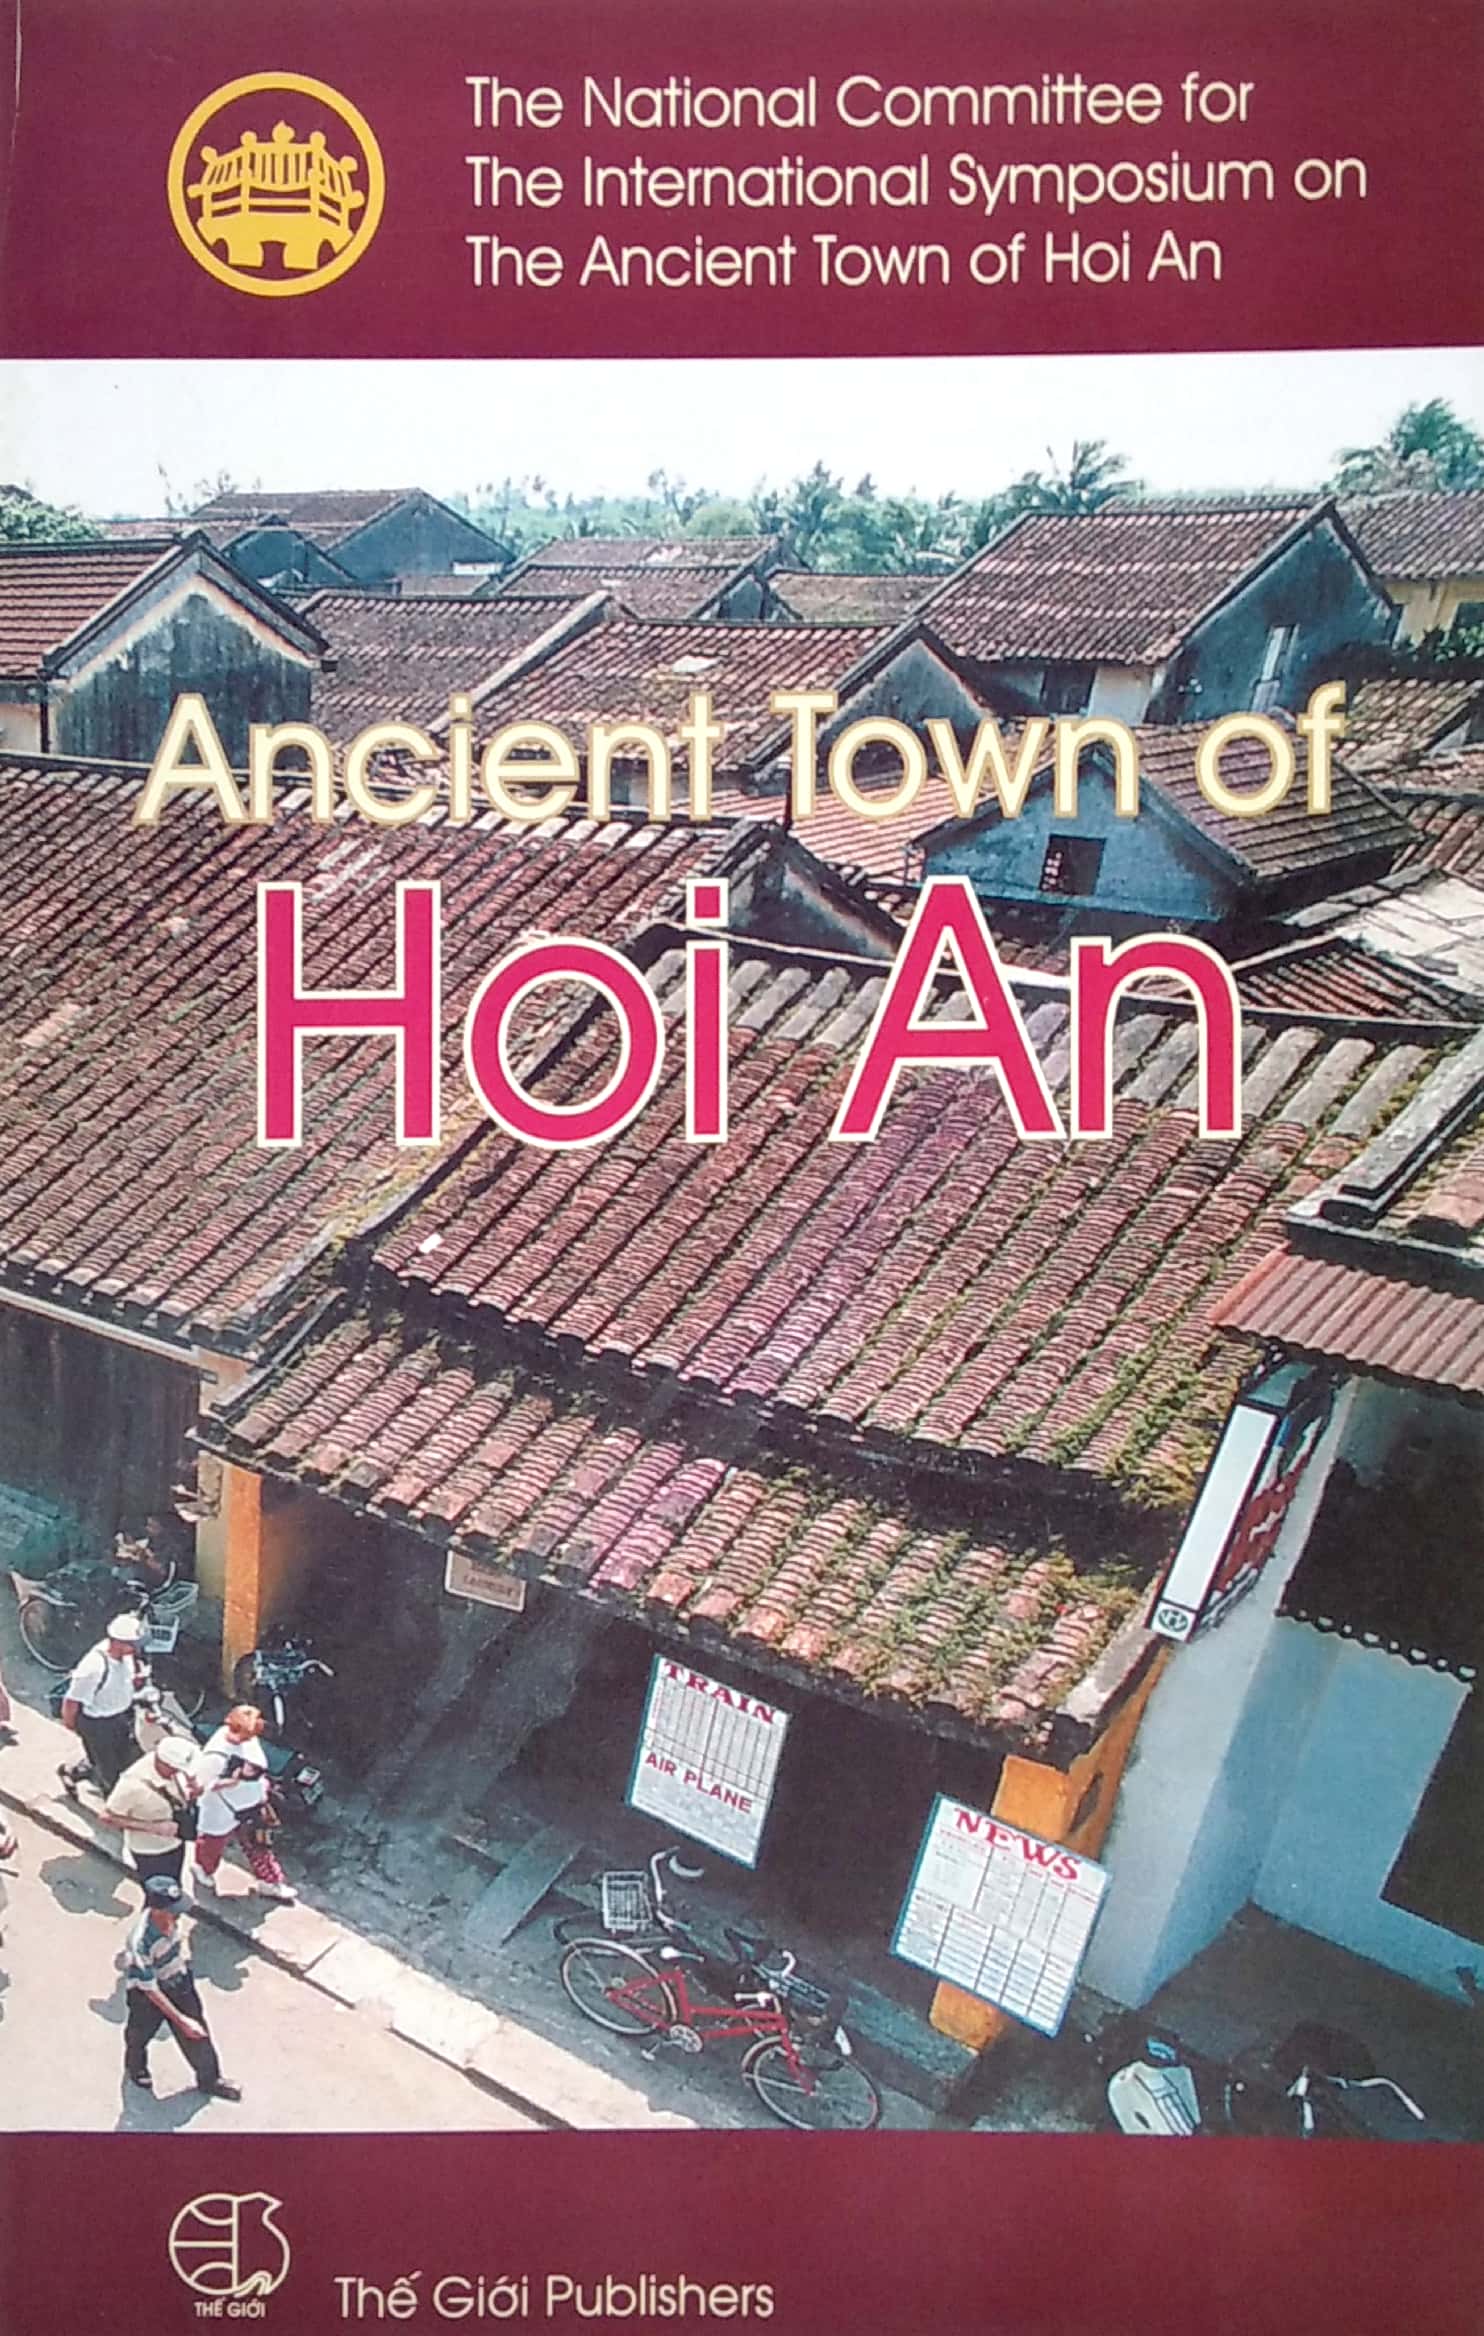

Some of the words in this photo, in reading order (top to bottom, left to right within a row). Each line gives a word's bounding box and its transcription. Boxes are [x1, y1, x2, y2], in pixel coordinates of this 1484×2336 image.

[465, 76, 564, 128] The
[584, 75, 816, 128] National
[836, 73, 1163, 128] Committee
[1181, 70, 1255, 123] for
[465, 156, 564, 208] The
[584, 154, 929, 207] International
[949, 151, 1274, 215] Symposium
[1294, 158, 1367, 200] on
[465, 235, 564, 287] The
[579, 235, 797, 287] Ancient
[812, 234, 950, 286] Town
[969, 232, 1026, 284] of
[1045, 230, 1130, 283] Hoi
[1147, 229, 1221, 281] An
[132, 692, 724, 825] Ancient
[770, 690, 1139, 819] Town
[1194, 681, 1346, 818] of
[257, 878, 728, 1149] Hoi
[828, 875, 1241, 1142] An
[663, 1661, 776, 1725] TRAIN
[645, 1751, 678, 1777] AIR
[682, 1768, 753, 1814] PLANE
[953, 1806, 1082, 1881] NEWS
[193, 2296, 226, 2317] THẾ
[334, 2270, 422, 2319] Thế
[433, 2275, 528, 2319] Giới
[547, 2274, 774, 2318] Publishers
